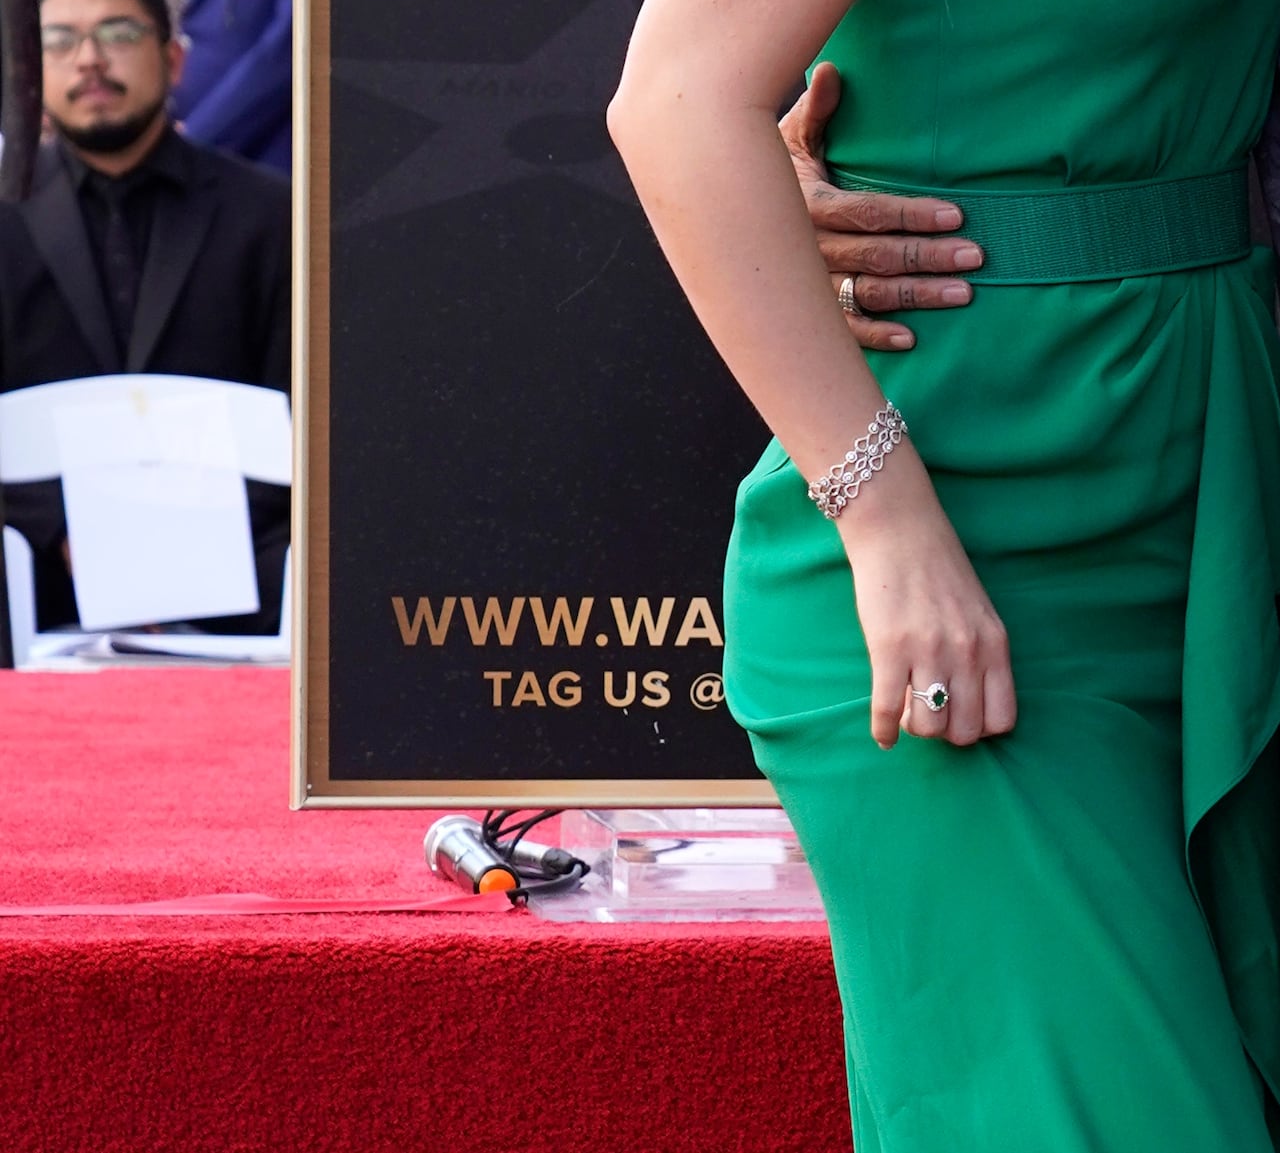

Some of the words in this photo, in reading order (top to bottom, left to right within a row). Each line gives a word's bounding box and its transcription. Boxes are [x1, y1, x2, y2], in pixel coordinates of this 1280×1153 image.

[391, 596, 724, 646] WWW.WA
[483, 670, 583, 708] TAG
[603, 670, 671, 708] US
